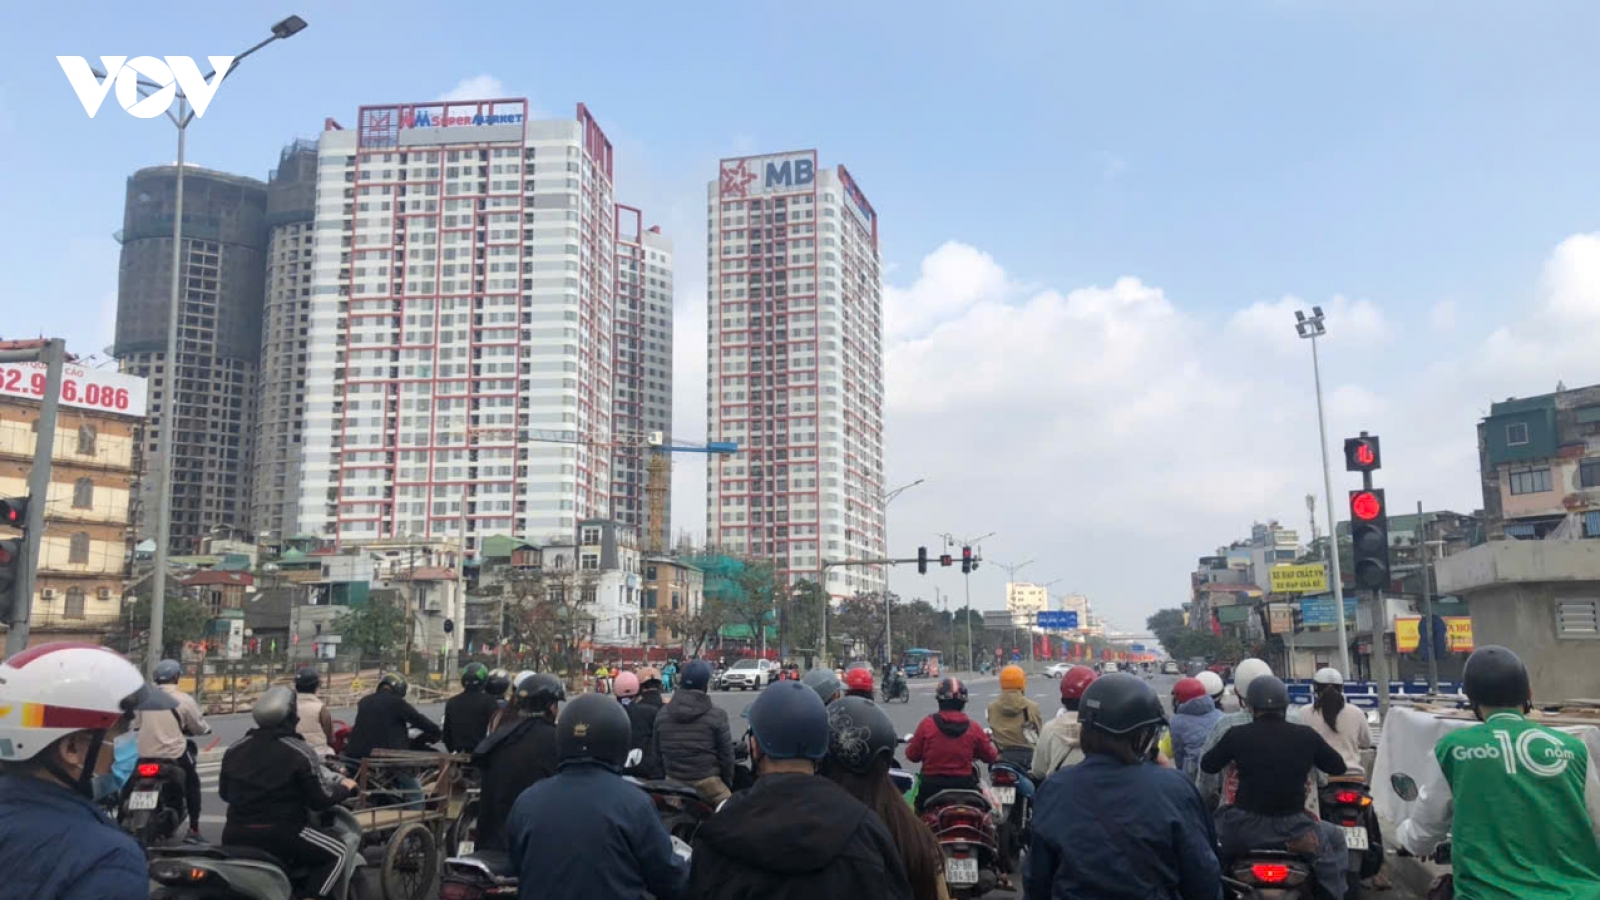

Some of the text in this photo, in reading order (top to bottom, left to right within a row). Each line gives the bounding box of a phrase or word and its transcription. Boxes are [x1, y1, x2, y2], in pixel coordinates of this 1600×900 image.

[765, 159, 814, 187] MB
[1452, 744, 1499, 760] Grab
[1493, 729, 1568, 776] 10
